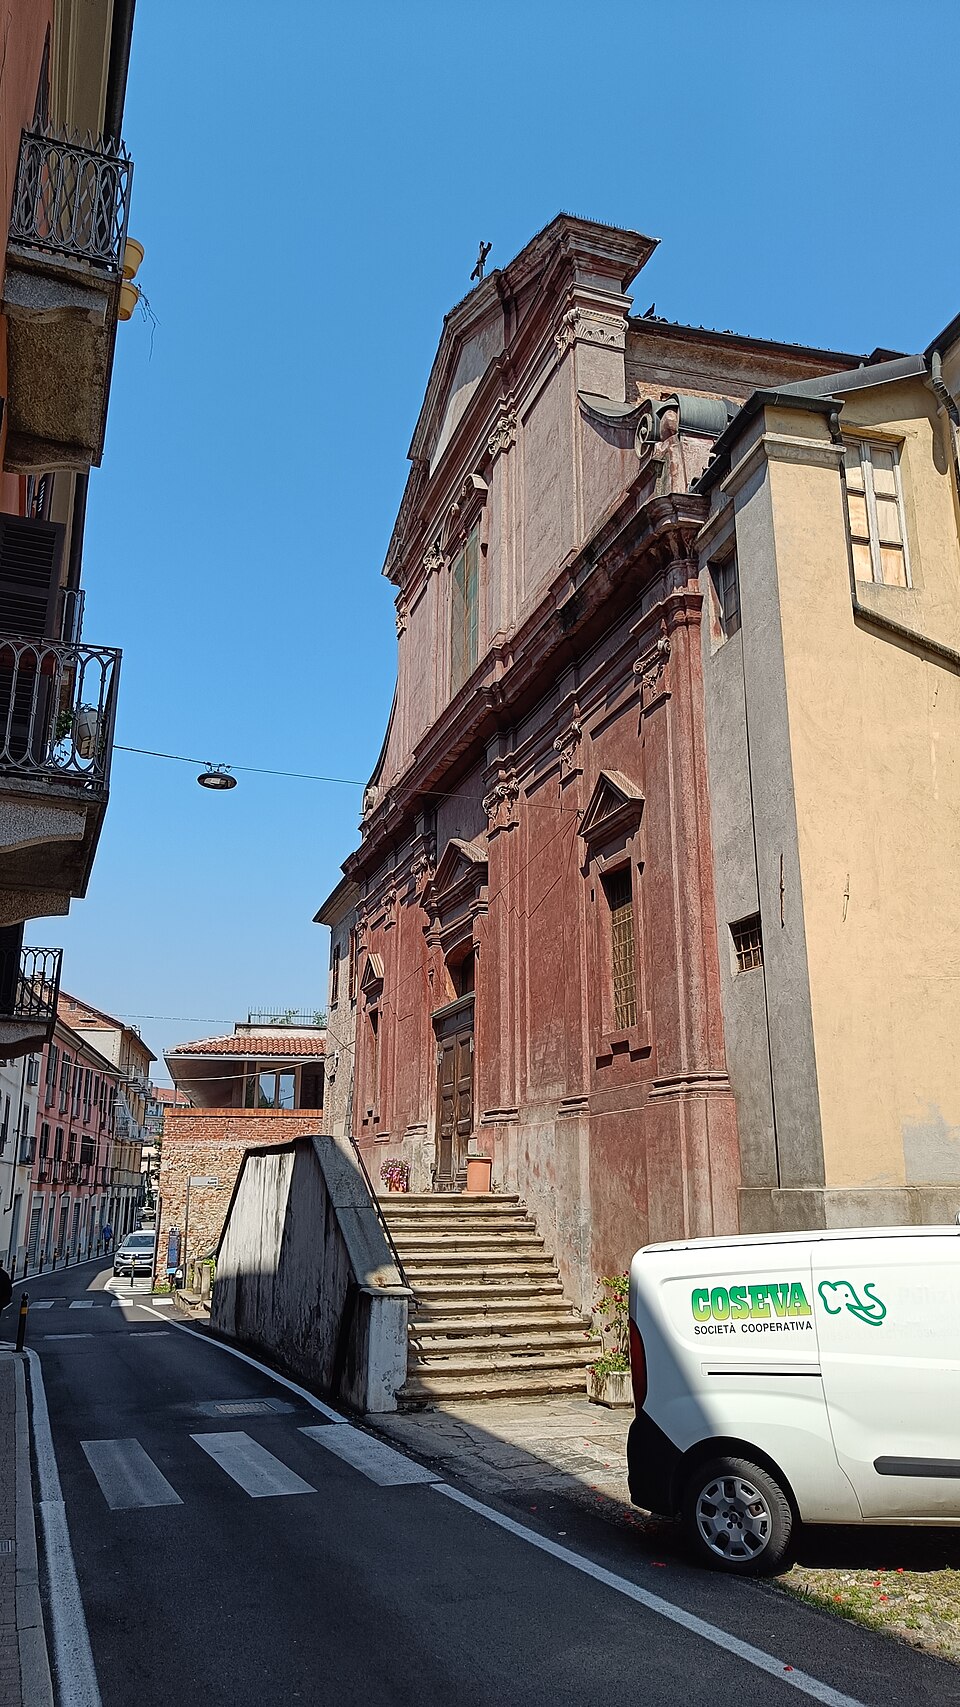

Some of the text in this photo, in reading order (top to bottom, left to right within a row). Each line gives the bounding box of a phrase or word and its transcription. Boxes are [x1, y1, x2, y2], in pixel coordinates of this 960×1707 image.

[691, 1282, 812, 1322] COSEVA
[694, 1321, 813, 1335] SOCIETÀ COOPERATIVA
